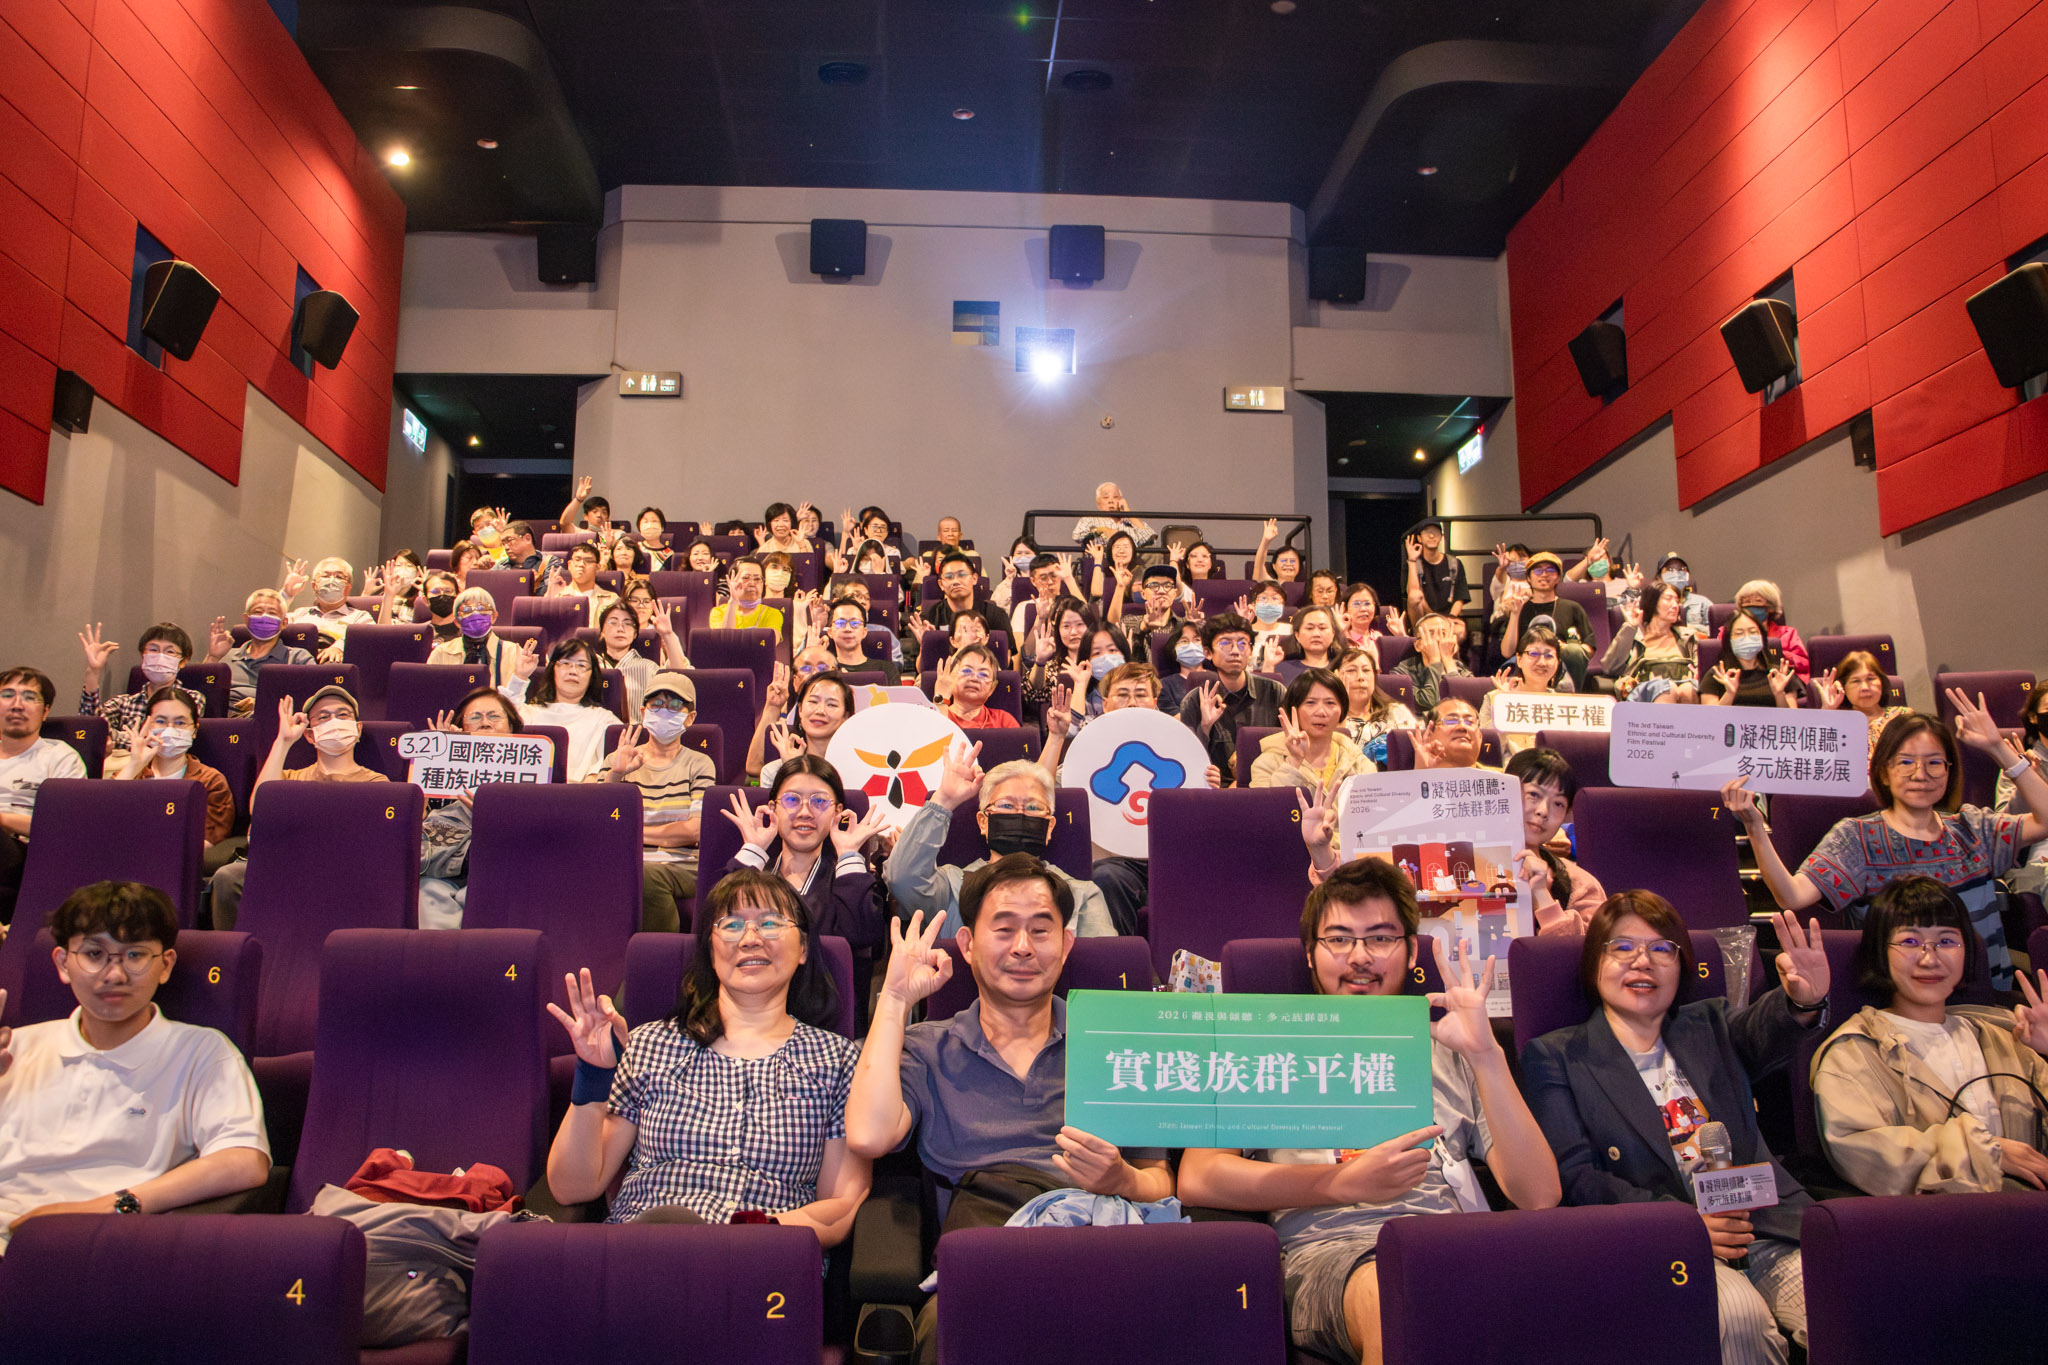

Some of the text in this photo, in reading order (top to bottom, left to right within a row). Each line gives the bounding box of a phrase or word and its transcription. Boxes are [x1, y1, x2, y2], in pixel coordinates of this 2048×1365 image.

[803, 558, 811, 566] 4
[371, 604, 380, 612] 12
[780, 606, 786, 614] 4
[882, 609, 888, 617] 2
[1288, 615, 1294, 623] 7
[296, 632, 306, 641] 12
[412, 633, 422, 642] 10
[644, 639, 651, 647] 6
[759, 639, 766, 647] 4
[876, 641, 883, 649] 2
[1880, 643, 1890, 651] 13
[1769, 648, 1777, 656] 11
[206, 675, 216, 684] 12
[334, 675, 344, 684] 10
[468, 675, 475, 684] 8
[602, 680, 609, 689] 6
[737, 680, 744, 689] 4
[1006, 684, 1011, 693] 1
[1399, 687, 1406, 696] 7
[2020, 682, 2031, 691] 13
[1891, 688, 1900, 697] 11
[1505, 702, 1606, 727] 族群平權
[1627, 721, 1640, 729] The
[1653, 722, 1675, 730] Taiwan
[75, 729, 86, 740] 12
[228, 734, 239, 744] 10
[1661, 731, 1686, 739] Cultural
[1687, 732, 1715, 741] Diversity
[1739, 723, 1848, 753] 凝視與傾聽:
[389, 737, 397, 747] 8
[403, 736, 440, 755] 3.21
[700, 739, 708, 749] 4
[448, 740, 544, 766] 國際消除
[1023, 743, 1029, 753] 1
[1484, 743, 1491, 753] 7
[1626, 749, 1655, 760] 2026
[1737, 755, 1851, 783] 多元族群影展
[165, 802, 175, 816] 8
[385, 806, 395, 820] 6
[1432, 798, 1510, 819] 多元族群影展
[1710, 807, 1720, 820] 7
[610, 807, 621, 821] 4
[1066, 811, 1073, 824] 1
[1290, 809, 1301, 823] 3
[840, 815, 850, 825] 2
[207, 966, 221, 984] 6
[504, 964, 518, 981] 4
[1413, 966, 1426, 984] 3
[1698, 962, 1710, 979] 5
[1119, 972, 1127, 989] 1
[1105, 1049, 1398, 1095] 實踐族群平權
[1670, 1260, 1689, 1286] 3
[285, 1278, 306, 1306] 4
[1236, 1283, 1248, 1310] 1
[766, 1291, 786, 1319] 2
